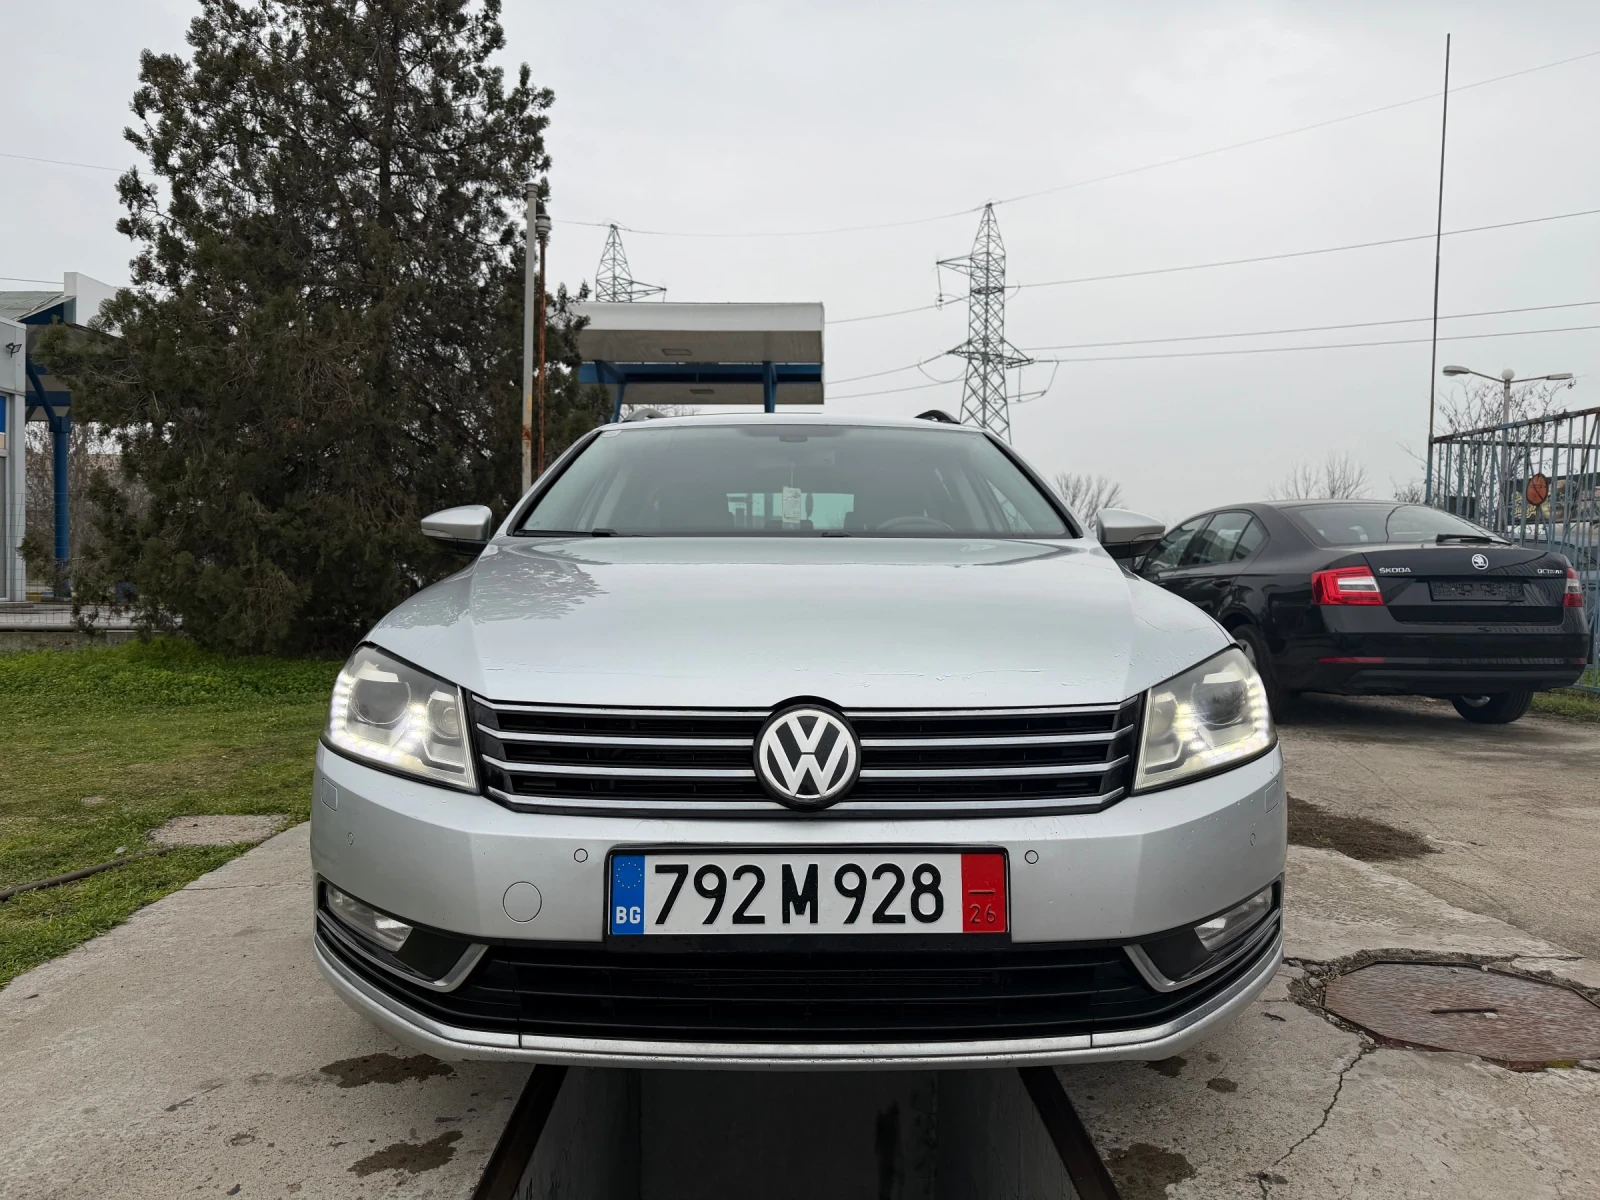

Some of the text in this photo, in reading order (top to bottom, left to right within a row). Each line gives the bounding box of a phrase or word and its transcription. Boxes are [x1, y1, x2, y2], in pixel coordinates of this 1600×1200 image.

[655, 863, 944, 925] 792 M 928
[616, 906, 641, 924] BG
[969, 903, 997, 924] 26
